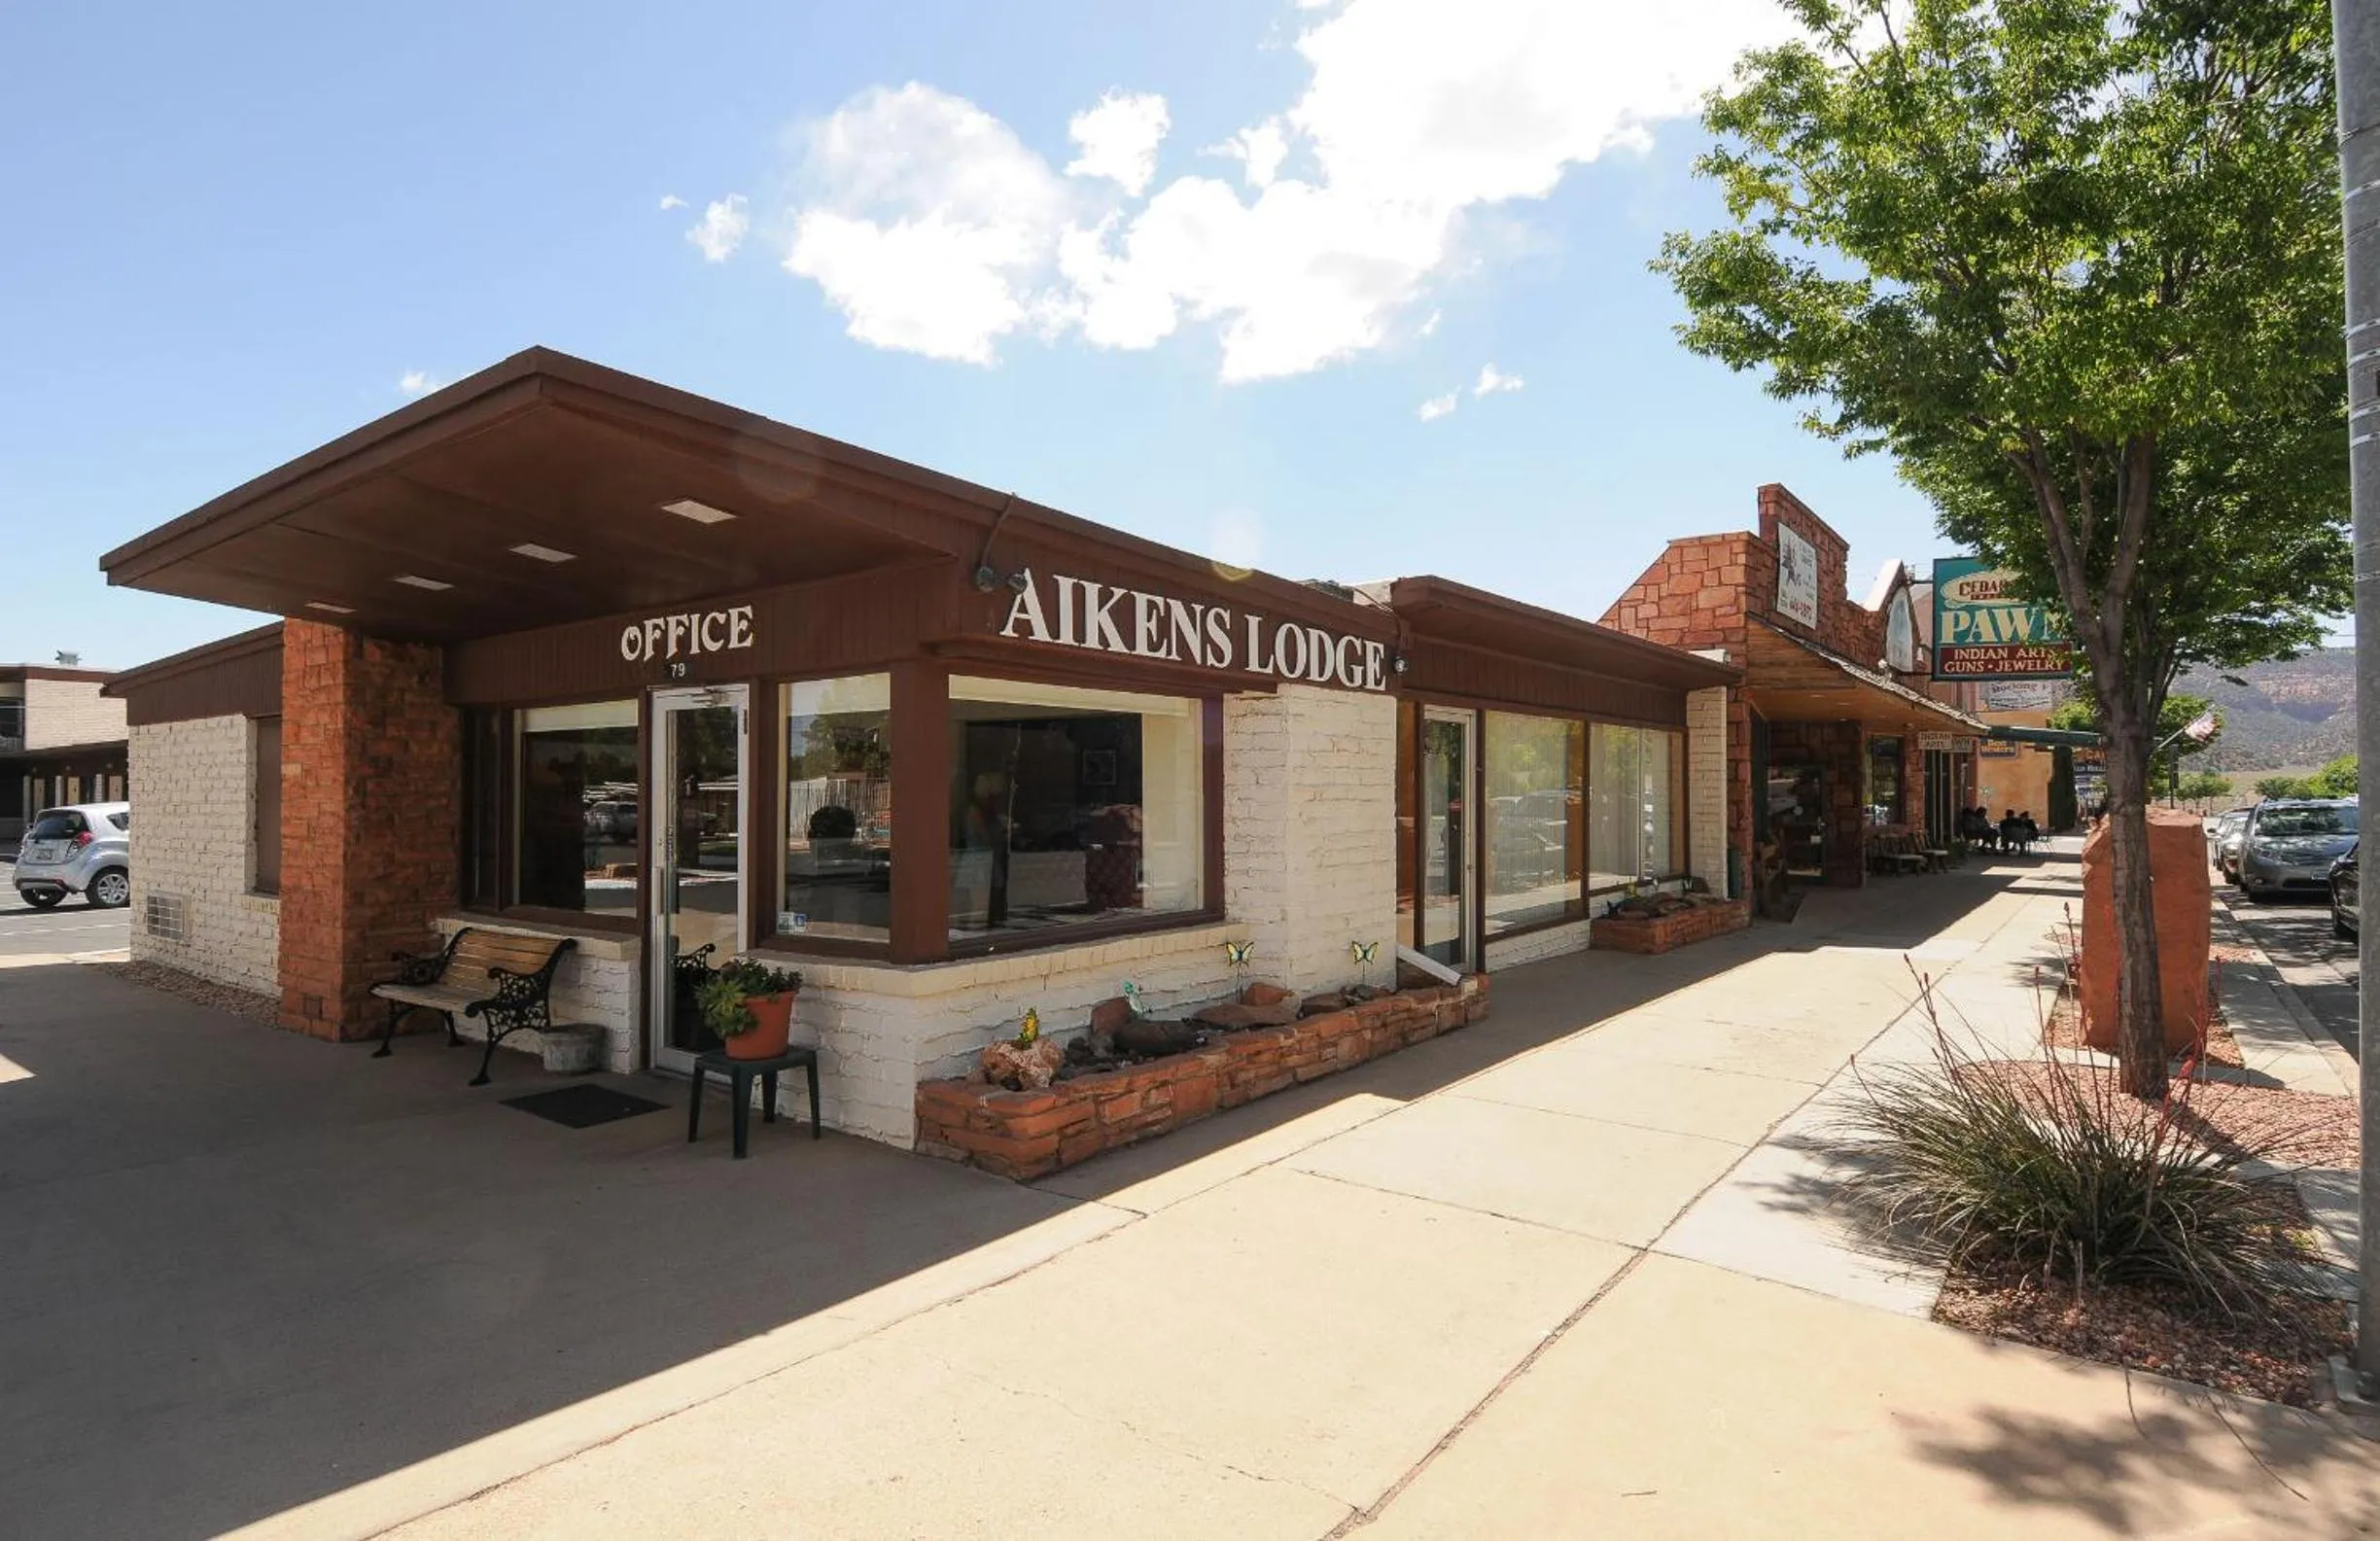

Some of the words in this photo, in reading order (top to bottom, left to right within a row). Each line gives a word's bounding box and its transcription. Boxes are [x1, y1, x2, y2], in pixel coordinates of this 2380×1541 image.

[621, 604, 753, 662] OFFICE
[999, 568, 1233, 670] AIKENS
[1244, 613, 1386, 691] LODGE
[1954, 648, 2009, 660] INDIAN
[2015, 648, 2058, 661] ARTS
[671, 663, 685, 678] 79
[1944, 661, 1984, 673] GUNS
[1996, 660, 2064, 673] JEWELRY
